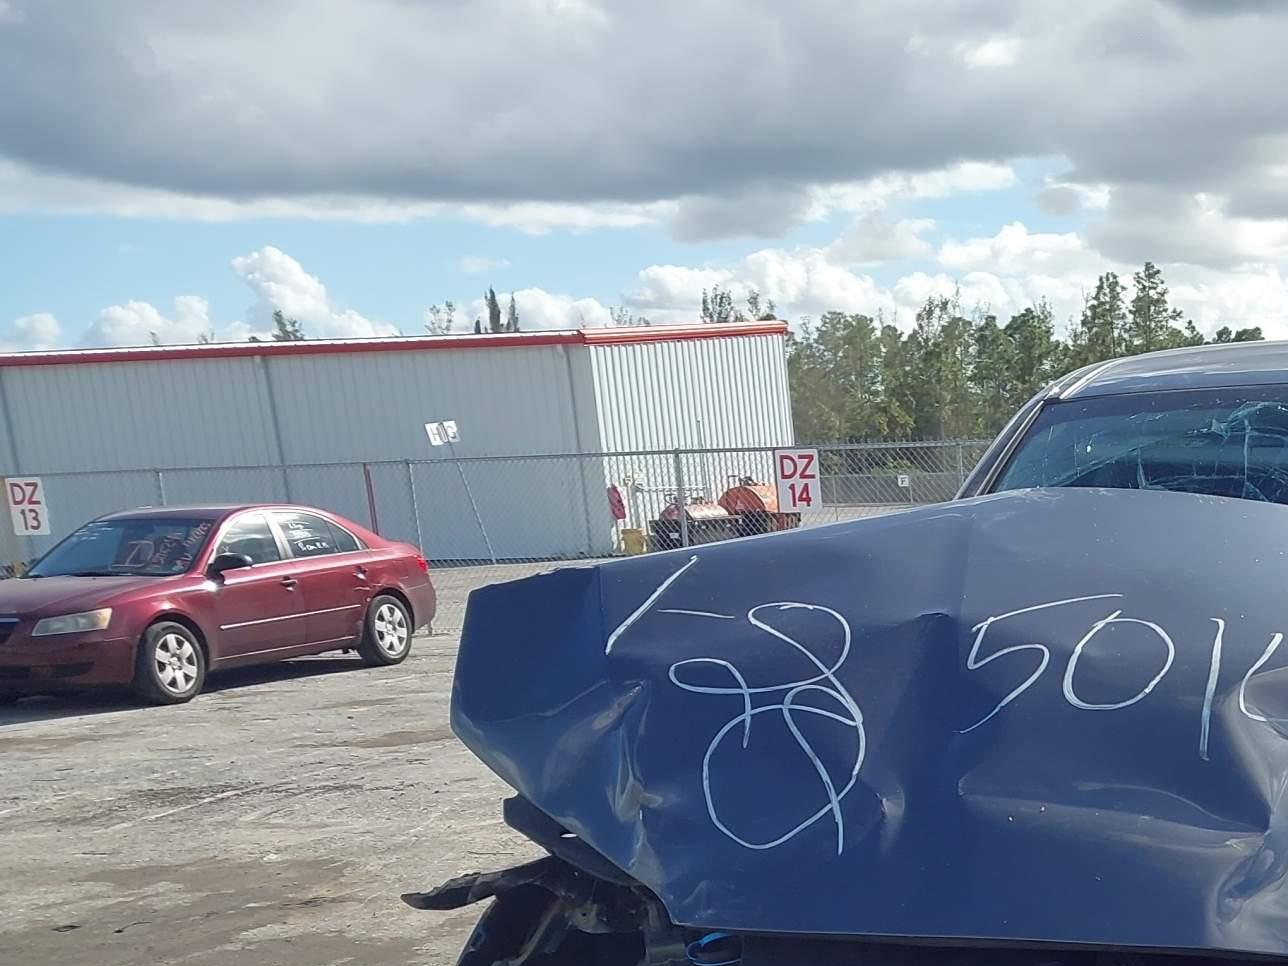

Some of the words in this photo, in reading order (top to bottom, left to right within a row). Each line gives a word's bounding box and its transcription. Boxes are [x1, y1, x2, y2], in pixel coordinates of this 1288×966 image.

[779, 455, 816, 480] DZ
[9, 482, 42, 506] DZ
[788, 483, 812, 508] 14
[20, 508, 42, 531] 13
